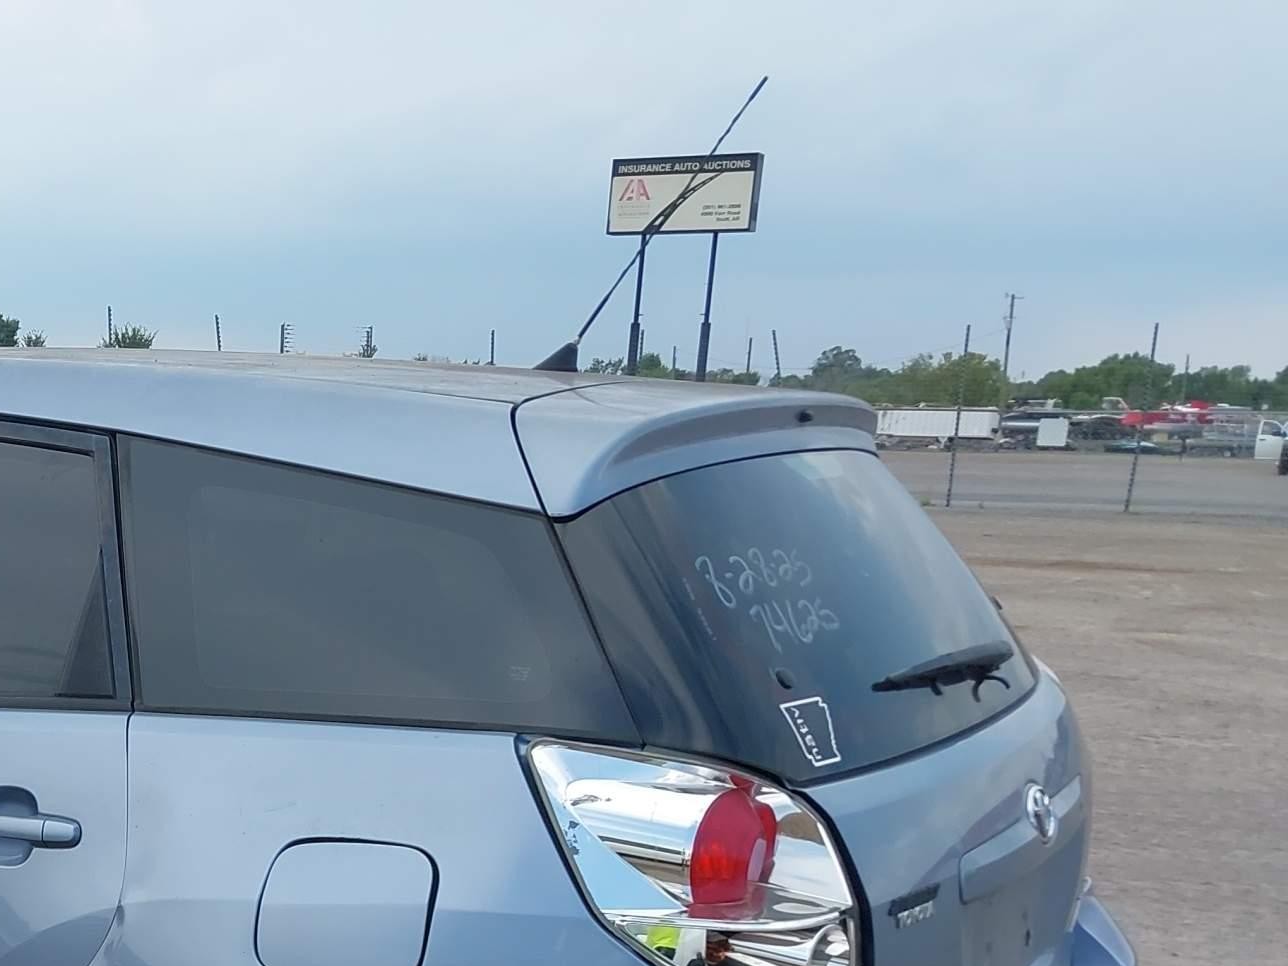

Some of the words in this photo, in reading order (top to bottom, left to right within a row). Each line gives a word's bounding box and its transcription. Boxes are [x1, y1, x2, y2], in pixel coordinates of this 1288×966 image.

[618, 163, 673, 174] INSURANCE
[673, 162, 700, 171] AUTO
[702, 159, 751, 170] AUCTIONS
